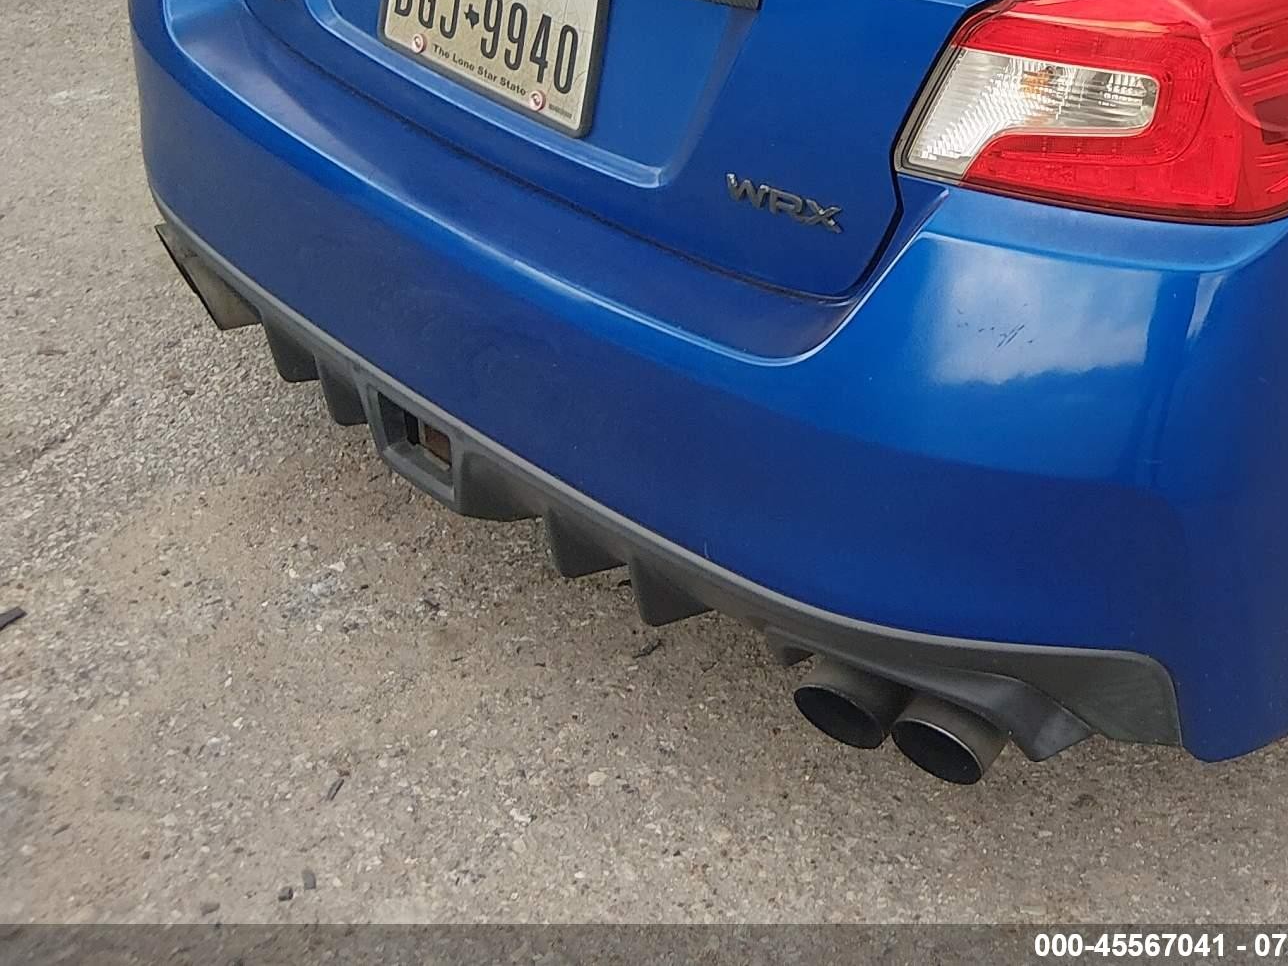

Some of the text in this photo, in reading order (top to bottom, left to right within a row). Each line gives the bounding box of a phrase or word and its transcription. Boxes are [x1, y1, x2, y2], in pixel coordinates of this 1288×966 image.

[432, 44, 527, 96] The Lone Star State
[726, 173, 843, 234] WRX
